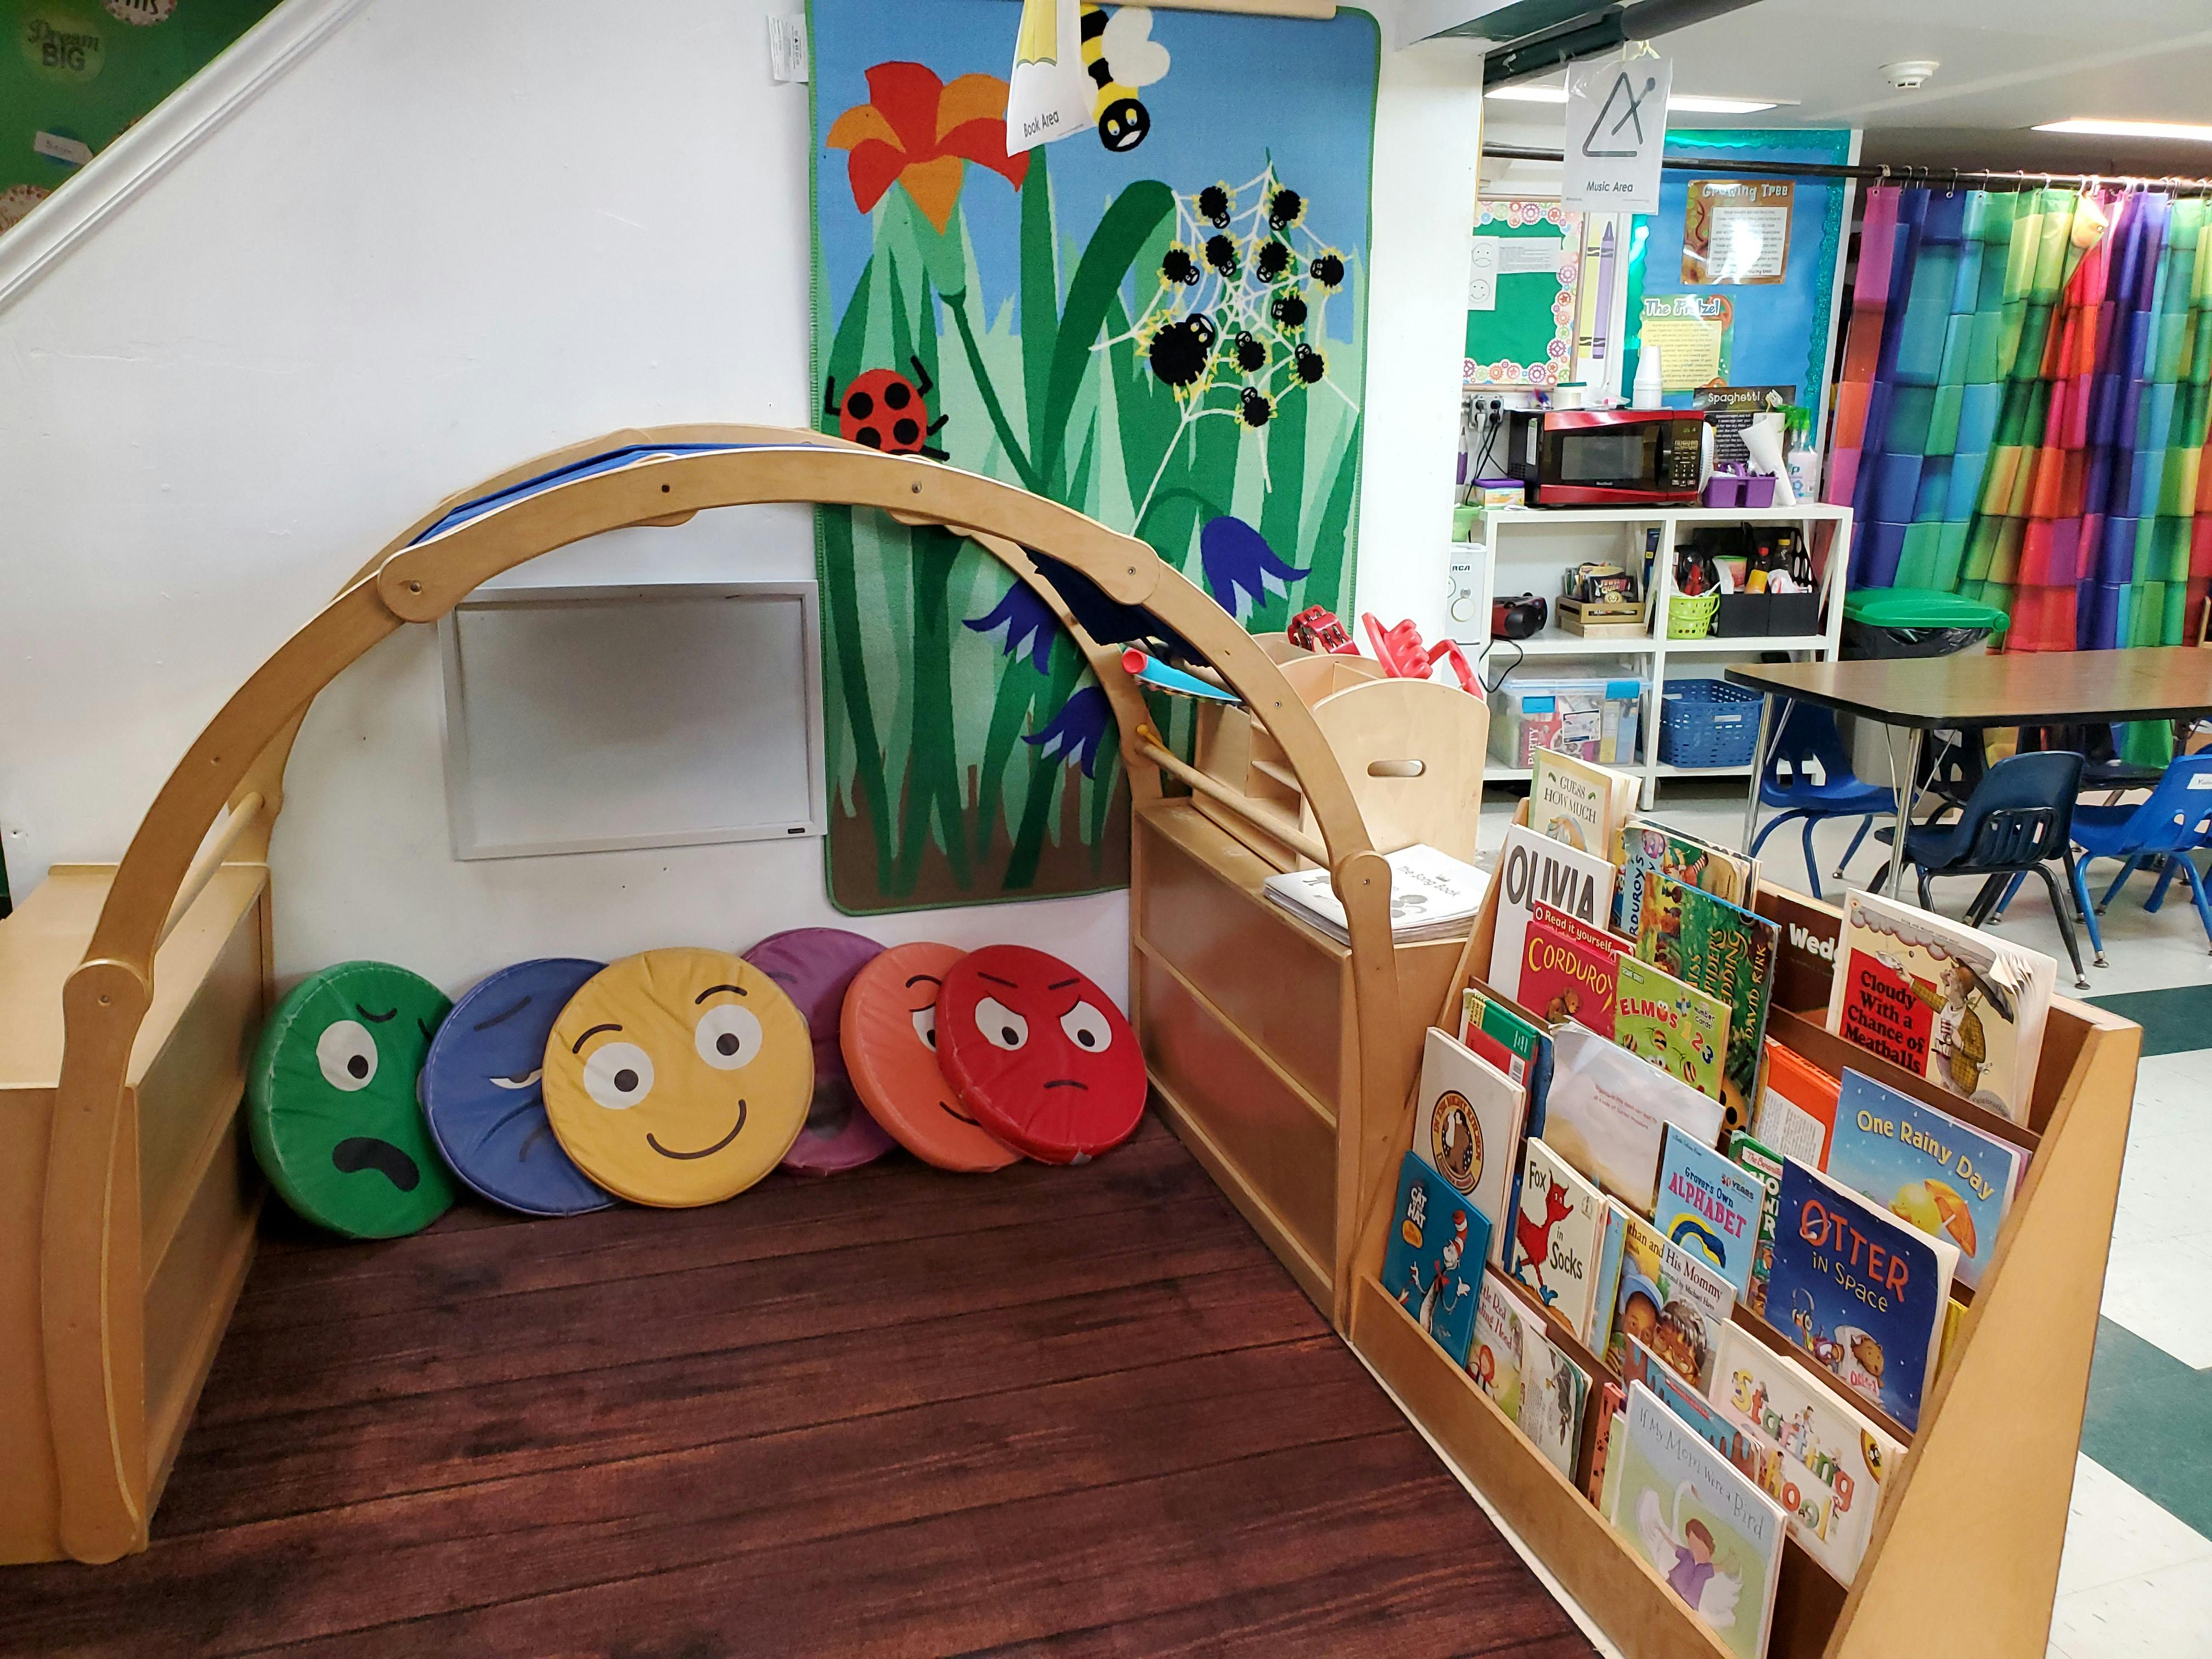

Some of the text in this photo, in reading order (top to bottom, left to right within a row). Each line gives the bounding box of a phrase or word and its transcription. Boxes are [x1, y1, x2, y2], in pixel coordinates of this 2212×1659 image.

[42, 42, 84, 71] BIG
[1023, 117, 1041, 138] Book
[1042, 110, 1059, 129] Area
[1587, 180, 1633, 192] Music Area
[1761, 184, 1788, 198] Tree
[1646, 299, 1670, 316] The
[1708, 391, 1761, 405] Spaghetti
[1543, 788, 1596, 824] HOW MUCH
[1560, 776, 1585, 799] GUESS
[1433, 884, 1462, 896] Book
[1506, 845, 1594, 925] OLIVIA
[1629, 854, 1646, 936] RDUROY'S
[1545, 910, 1567, 930] Read
[1568, 921, 1576, 934] it
[1576, 928, 1612, 953] yourself
[1720, 930, 1748, 1006] EDDING
[1743, 943, 1767, 1040] DAVID KIRK
[1861, 969, 1917, 1011] Cloudy
[1694, 1006, 1716, 1022] Number
[1847, 1004, 1926, 1054] Chance of
[1860, 990, 1913, 1030] With a
[1680, 1020, 1714, 1065] 1 2 3
[1845, 1023, 1921, 1074] Meatballs
[1857, 1110, 1894, 1138] One
[1900, 1120, 1953, 1166] Rainy
[1955, 1154, 1995, 1201] Day
[1528, 1160, 1547, 1193] Fox
[1684, 1166, 1714, 1194] Grover's
[1716, 1187, 1734, 1209] Own
[1732, 1180, 1754, 1200] YEARS
[1407, 1201, 1426, 1229] HAT
[1411, 1187, 1427, 1208] CAT
[1668, 1171, 1747, 1239] ALPHABET
[1556, 1226, 1564, 1241] in
[1801, 1199, 1909, 1303] OTTER
[1549, 1241, 1583, 1280] Socks
[1649, 1241, 1664, 1259] and
[1666, 1248, 1681, 1272] His
[1683, 1261, 1723, 1303] Mommy
[1492, 1293, 1506, 1321] Red
[1834, 1262, 1888, 1313] Space
[1639, 1407, 1764, 1540] If My Mom Were a Bird
